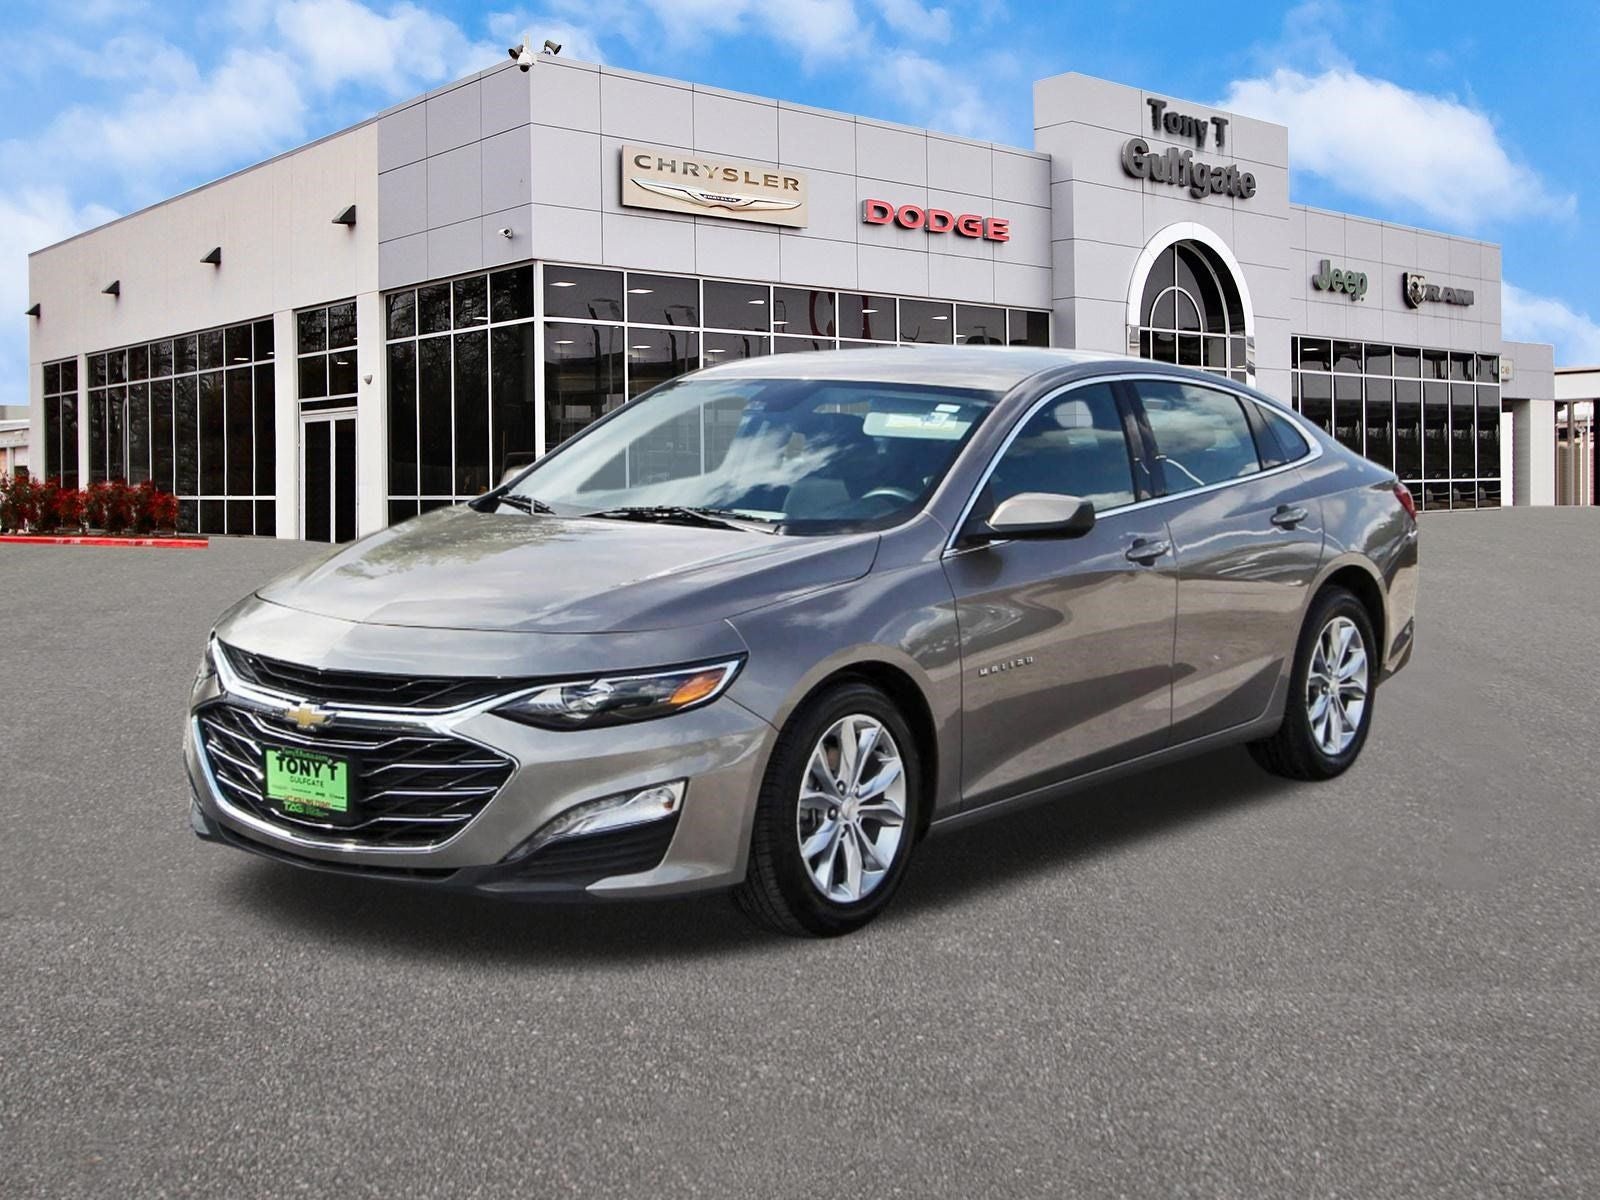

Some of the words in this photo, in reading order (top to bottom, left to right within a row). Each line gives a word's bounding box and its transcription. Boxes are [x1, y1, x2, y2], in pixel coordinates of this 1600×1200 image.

[1146, 98, 1208, 148] Tony
[1210, 116, 1229, 147] T
[633, 153, 800, 193] CHRYSLER
[1121, 138, 1256, 199] Gulfgate
[863, 198, 1010, 243] DODGE
[1312, 259, 1368, 301] Jeep
[1424, 284, 1475, 306] RAM
[275, 755, 322, 778] TONY
[327, 764, 338, 781] T
